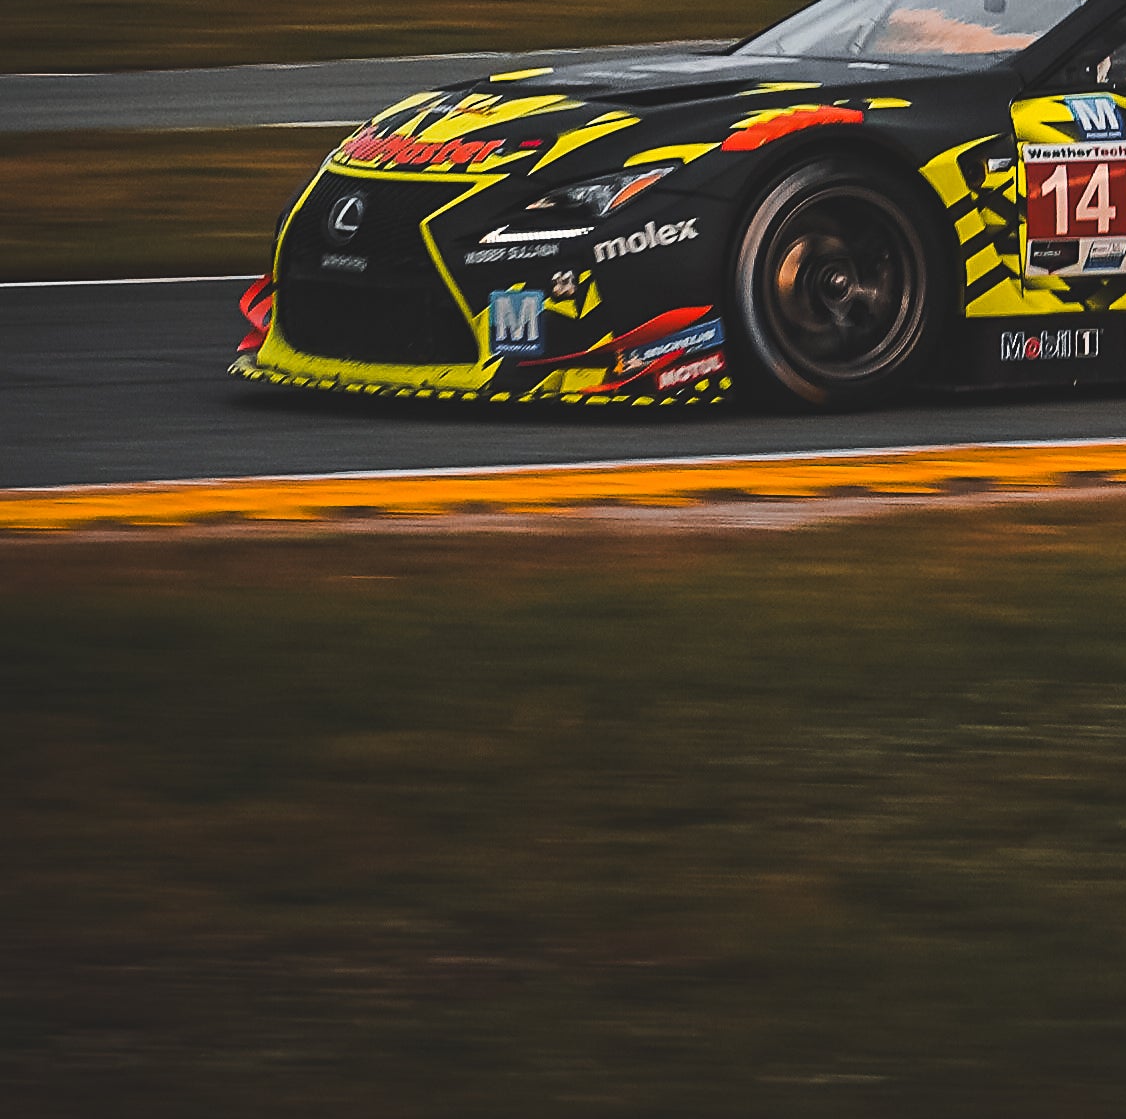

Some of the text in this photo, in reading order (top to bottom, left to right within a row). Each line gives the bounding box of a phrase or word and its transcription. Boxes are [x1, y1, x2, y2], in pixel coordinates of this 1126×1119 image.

[1072, 98, 1120, 131] M
[1041, 162, 1117, 236] 14
[593, 217, 700, 263] molex
[494, 295, 540, 342] M
[1000, 329, 1072, 361] Mobil
